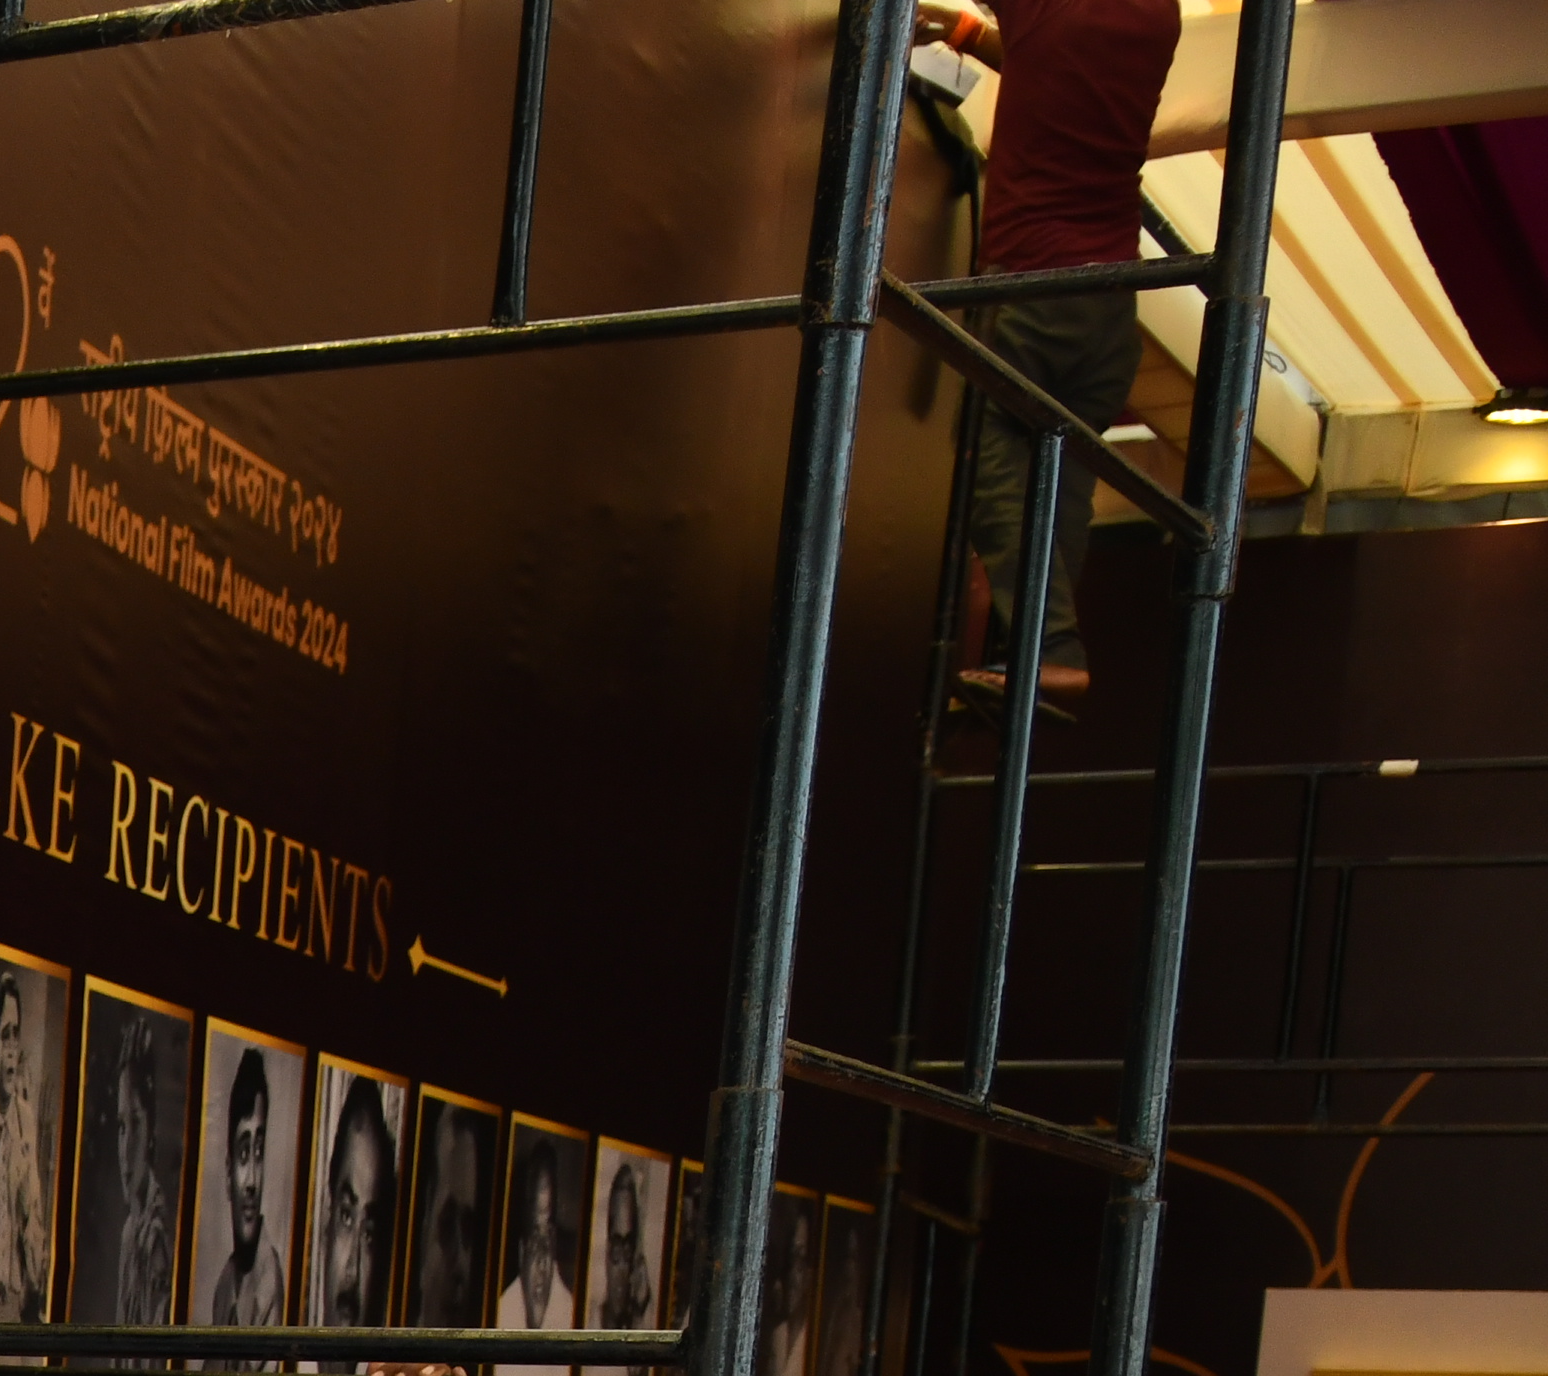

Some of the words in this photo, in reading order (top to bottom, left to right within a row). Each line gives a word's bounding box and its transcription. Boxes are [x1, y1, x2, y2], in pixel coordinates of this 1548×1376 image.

[67, 463, 167, 576] National
[167, 524, 216, 604] Film
[216, 556, 298, 648] Awards
[298, 597, 349, 676] 2024
[103, 758, 392, 983] RECIPIENTS
